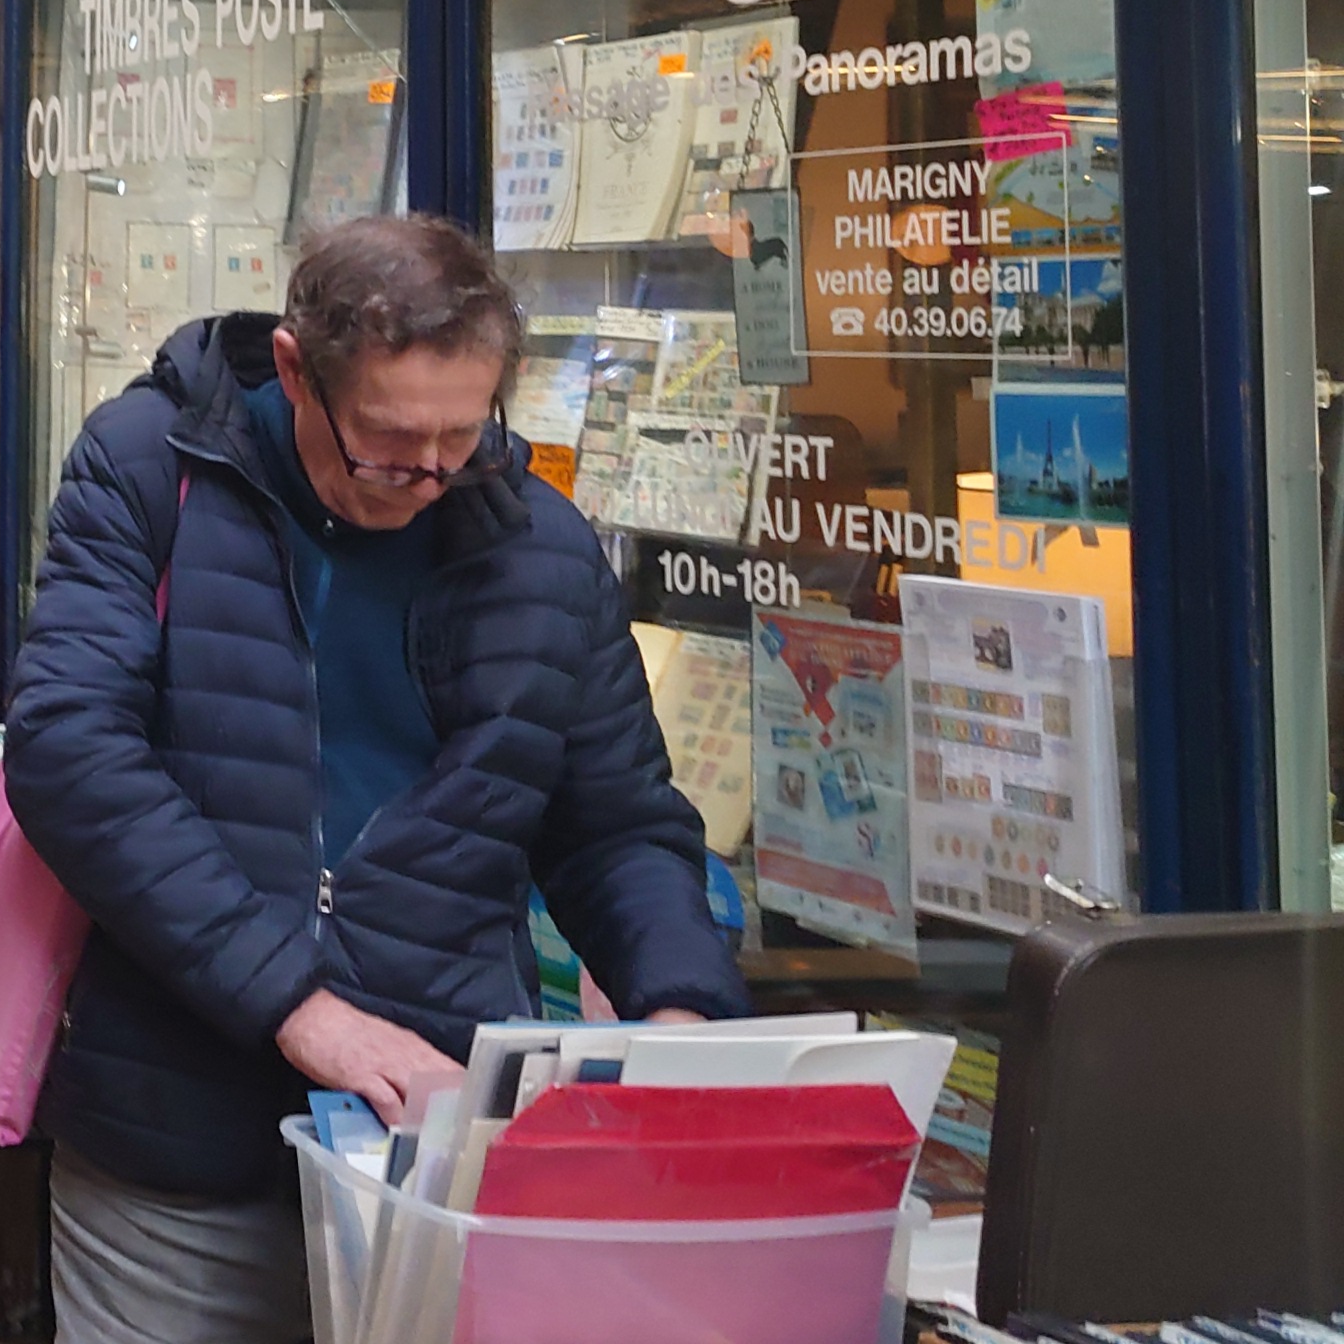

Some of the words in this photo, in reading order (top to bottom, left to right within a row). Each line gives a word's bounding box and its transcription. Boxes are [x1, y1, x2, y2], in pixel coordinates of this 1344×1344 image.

[789, 27, 1032, 97] Panoramas
[26, 68, 212, 179] COLLECTIONS
[847, 159, 993, 204] MARIGNY
[835, 208, 1012, 250] PHILATELIE
[816, 265, 893, 296] vente
[904, 265, 942, 295] au
[949, 258, 1039, 296] détail
[874, 306, 1023, 339] 40.39.06.74
[683, 429, 834, 482] OUVERT
[753, 497, 800, 543] AU
[816, 503, 1046, 574] VENDREDI
[657, 548, 801, 609] 10h-18h
